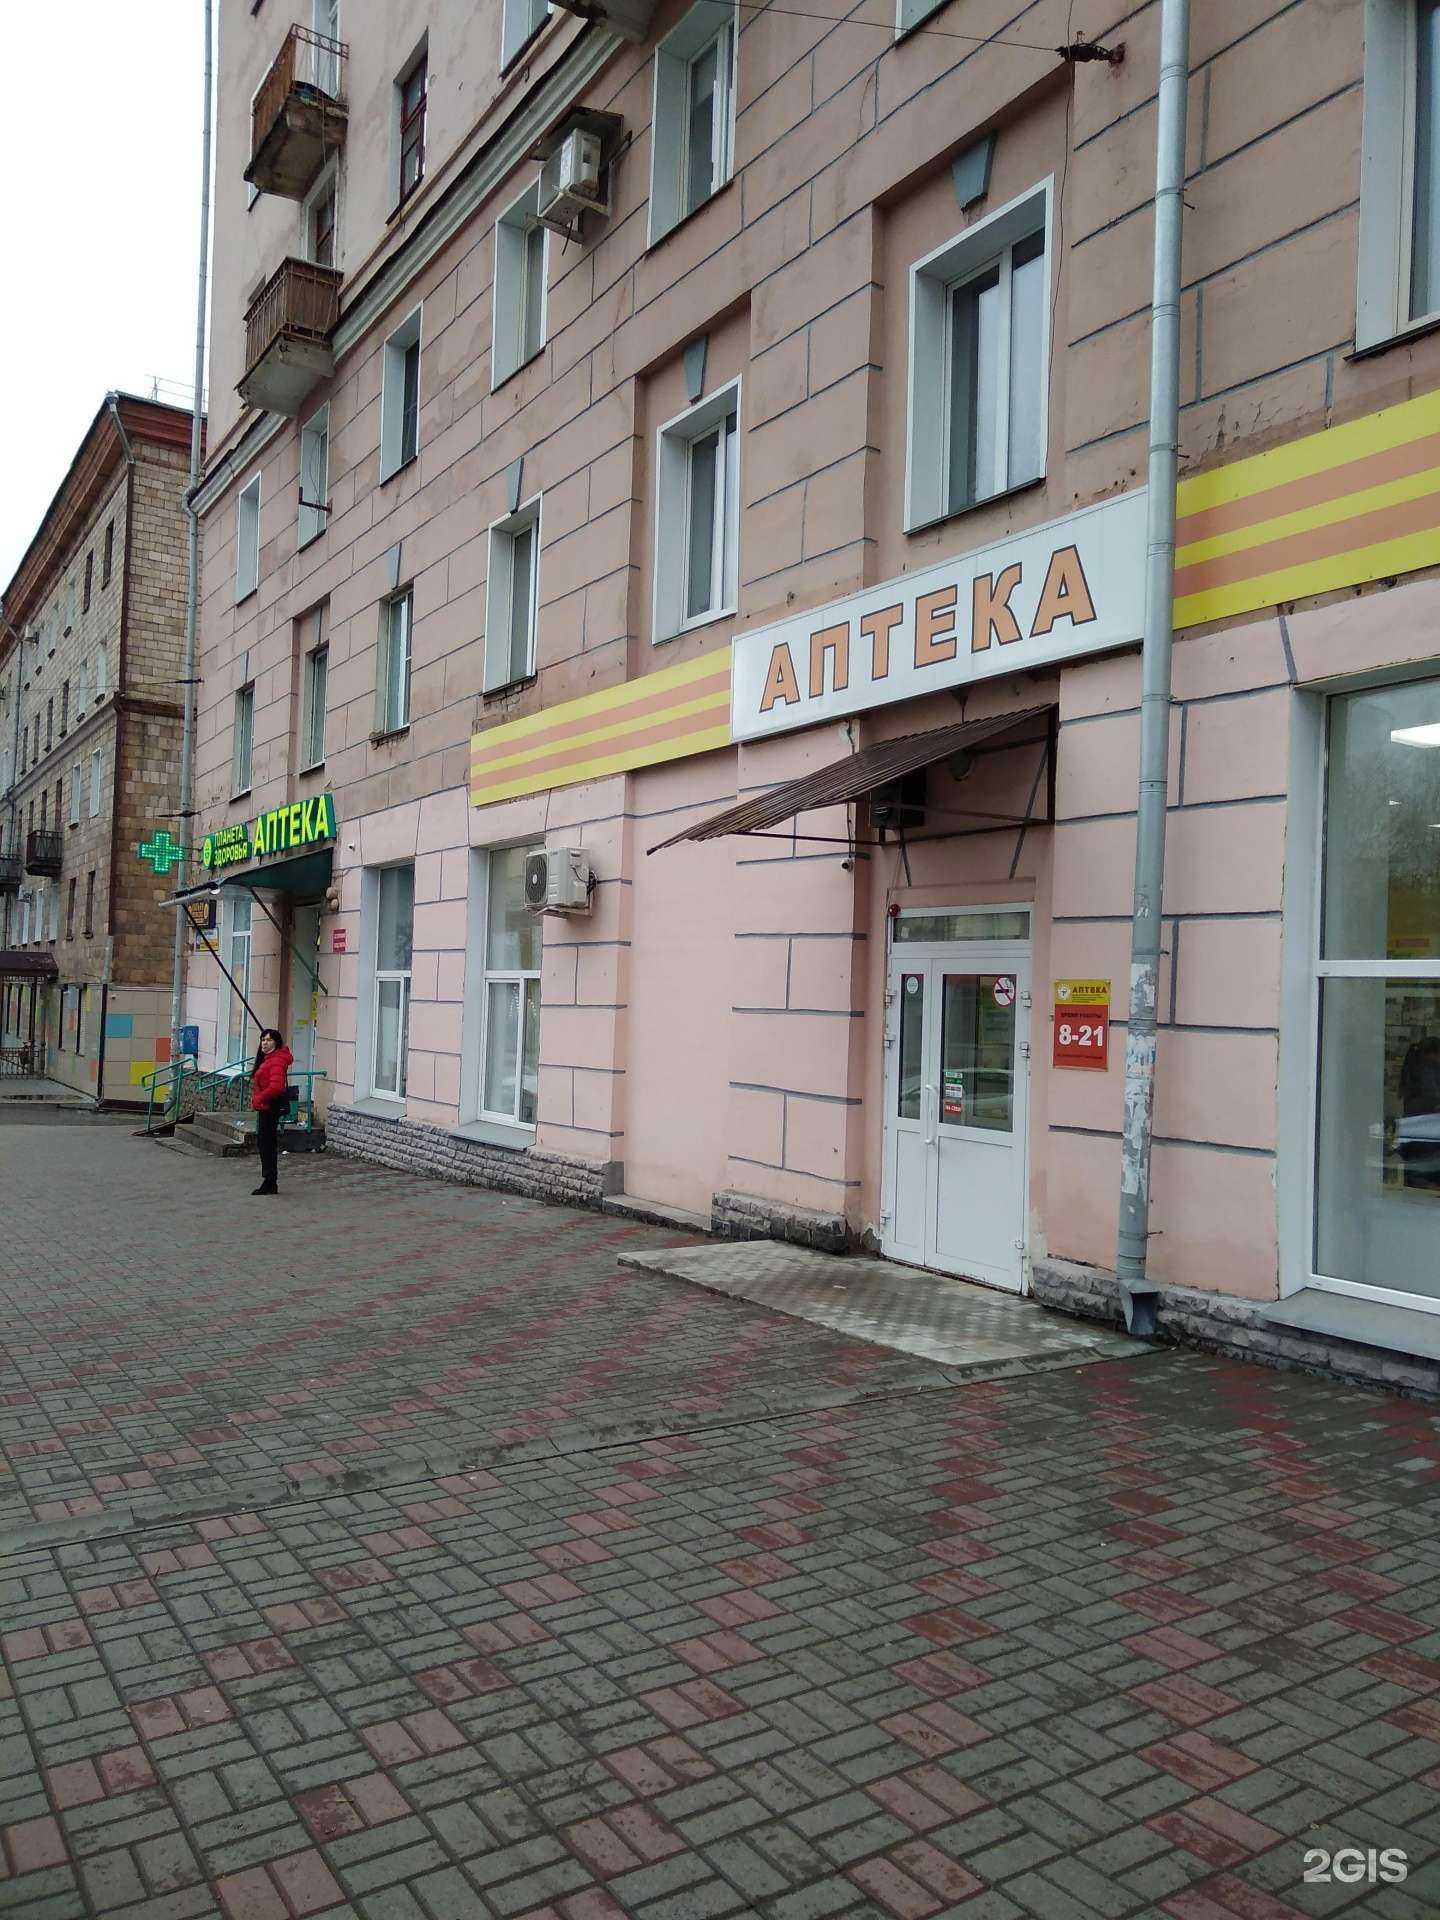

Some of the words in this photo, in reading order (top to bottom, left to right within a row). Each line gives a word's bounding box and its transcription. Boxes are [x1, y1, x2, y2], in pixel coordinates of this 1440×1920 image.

[758, 543, 1098, 713] АПТЕКА
[214, 824, 244, 847] ПЛАНЕТА
[253, 794, 329, 856] АПТЕКА
[213, 841, 248, 867] ЗДОРОВЬЯ
[1072, 986, 1107, 994] АПТЕКА
[1058, 1024, 1104, 1047] 8-21
